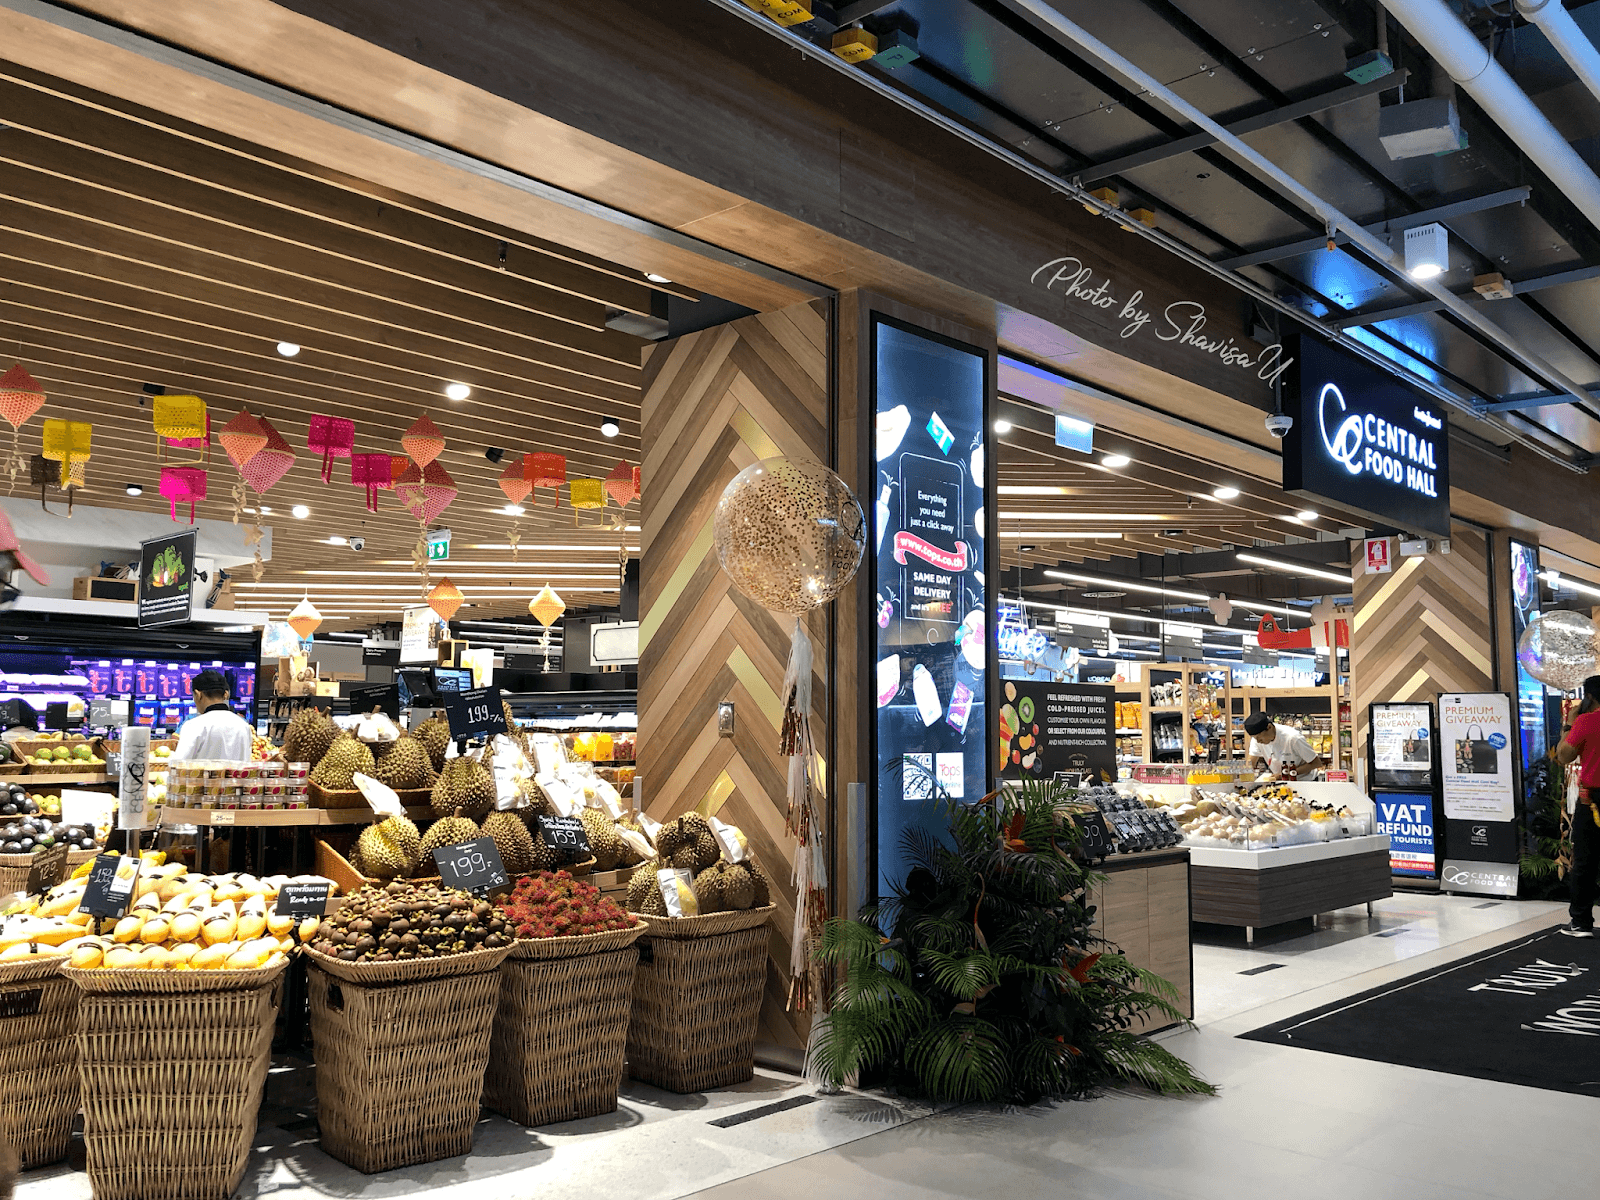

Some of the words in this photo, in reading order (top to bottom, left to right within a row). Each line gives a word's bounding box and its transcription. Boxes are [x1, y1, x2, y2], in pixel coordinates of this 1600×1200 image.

[778, 7, 804, 19] COM
[842, 47, 868, 58] COM
[1364, 413, 1437, 470] CENTRAL
[1364, 447, 1403, 484] FOOD
[1406, 465, 1438, 498] HALL
[917, 490, 948, 506] Everything
[919, 507, 931, 518] you
[931, 508, 946, 518] need
[910, 516, 921, 529] just
[926, 518, 940, 530] click
[940, 522, 955, 534] away
[900, 538, 963, 568] www.tops.co.th
[913, 571, 935, 583] SAME
[936, 575, 952, 585] DAY
[913, 586, 952, 599] DELIVERY
[1047, 693, 1058, 701] FEEL
[1057, 694, 1081, 702] REFRESHED
[1047, 705, 1087, 713] COLD-PRESSED
[1087, 706, 1107, 715] JUICES.
[1445, 706, 1494, 715] PREMIUM
[1079, 717, 1090, 725] OWN
[1376, 712, 1416, 720] PREMIUM
[1445, 715, 1503, 724] GIVEAWAY
[1376, 720, 1423, 728] GIVEAWAY
[1047, 727, 1054, 735] OR
[1380, 802, 1427, 823] VAT
[1376, 822, 1433, 837] REFUND
[1393, 836, 1433, 846] TOURISTS
[1470, 872, 1518, 882] CENTRAL
[1466, 957, 1590, 996] TRULY
